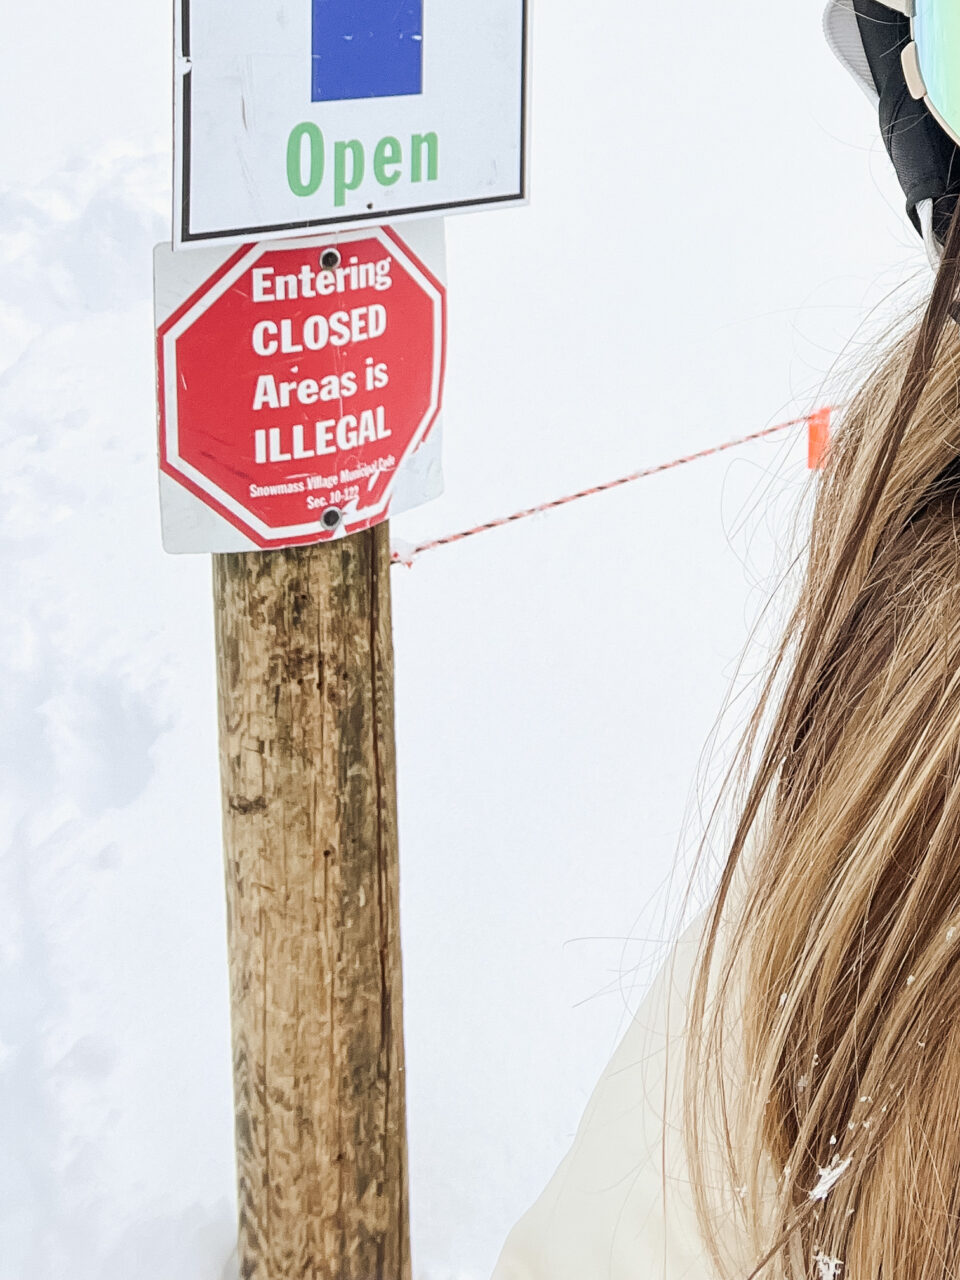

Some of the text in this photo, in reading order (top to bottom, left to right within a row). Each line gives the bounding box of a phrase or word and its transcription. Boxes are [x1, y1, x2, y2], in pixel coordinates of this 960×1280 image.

[286, 121, 439, 207] Open
[252, 256, 392, 303] Entering
[252, 303, 387, 356] CLOSED
[253, 357, 389, 411] Areas is
[254, 406, 392, 464] ILLEGAL
[250, 481, 305, 498] Snowmass
[306, 474, 339, 491] Village
[306, 494, 329, 510] Sec.
